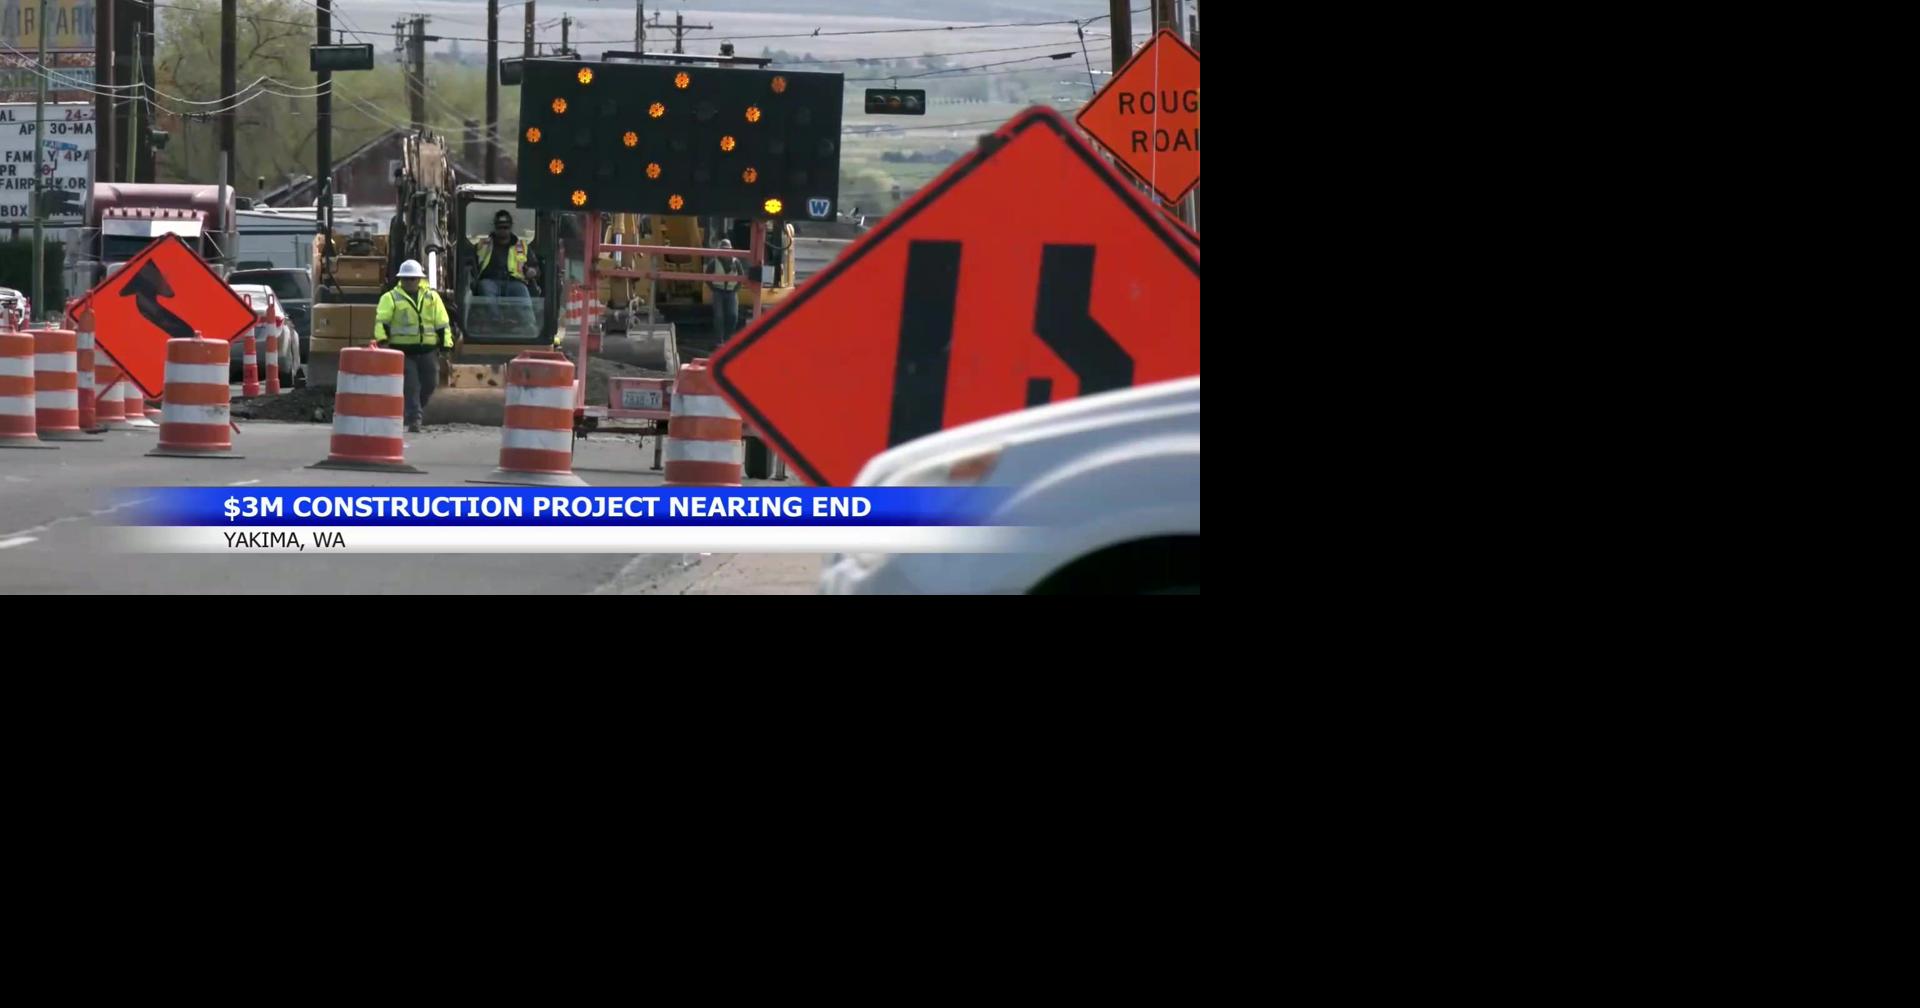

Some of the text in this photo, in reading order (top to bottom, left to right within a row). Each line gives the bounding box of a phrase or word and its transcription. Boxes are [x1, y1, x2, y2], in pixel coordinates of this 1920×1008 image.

[1119, 89, 1199, 114] ROUG
[19, 124, 41, 135] AP
[5, 151, 56, 162] FAMY
[0, 205, 27, 217] BOX
[809, 199, 829, 216] W
